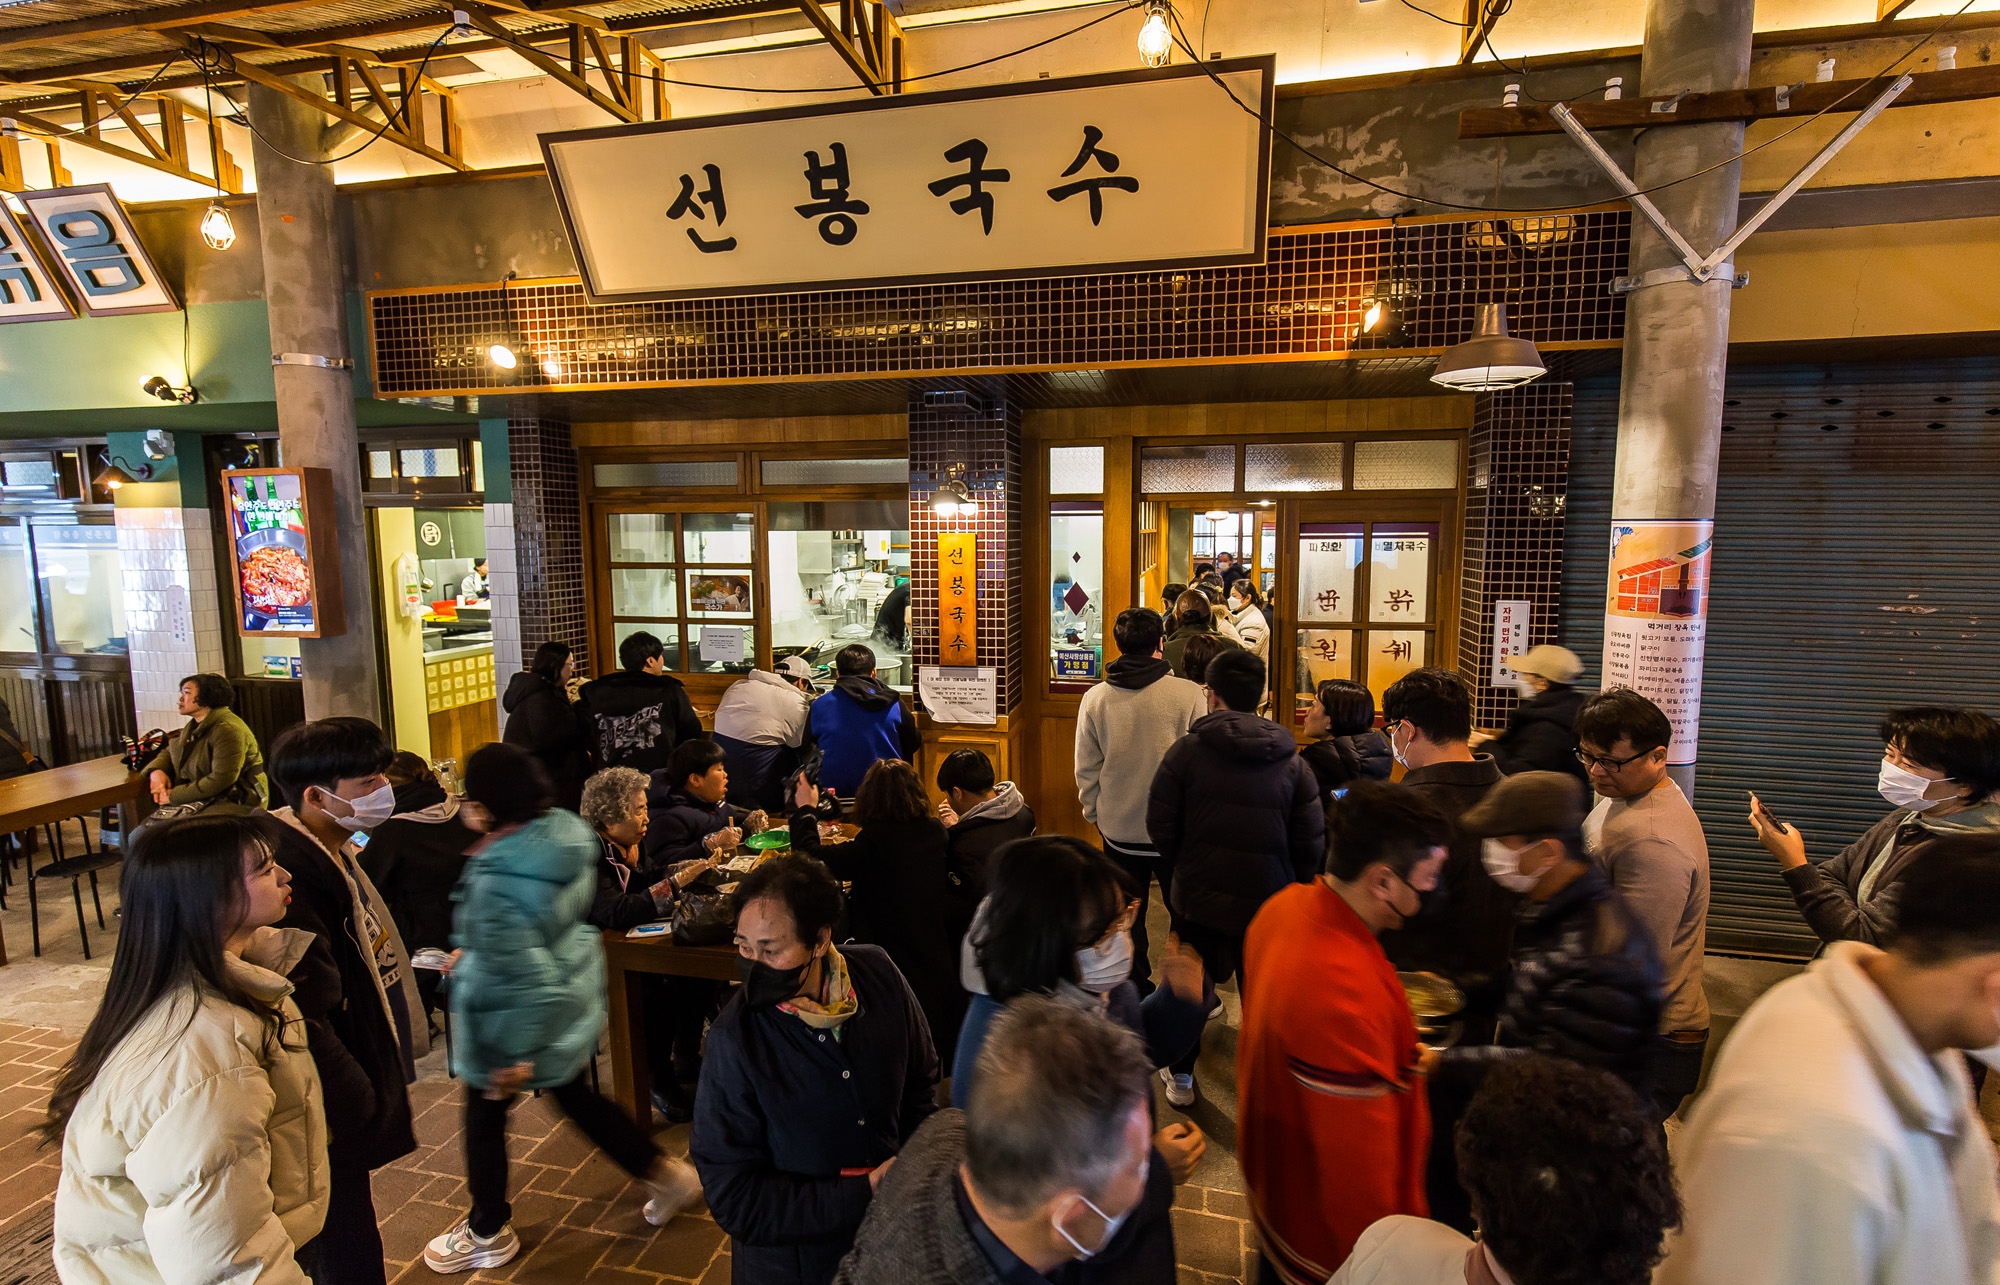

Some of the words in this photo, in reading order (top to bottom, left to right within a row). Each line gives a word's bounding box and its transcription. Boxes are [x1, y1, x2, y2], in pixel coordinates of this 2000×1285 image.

[948, 547, 968, 652] 선봉국수
[1502, 607, 1512, 624] 자리
[1514, 624, 1521, 638] 메뉴
[1647, 623, 1672, 631] 먹거리
[1501, 627, 1510, 644] 먼저
[1063, 660, 1089, 669] 가맹점
[1500, 667, 1508, 676] 후
